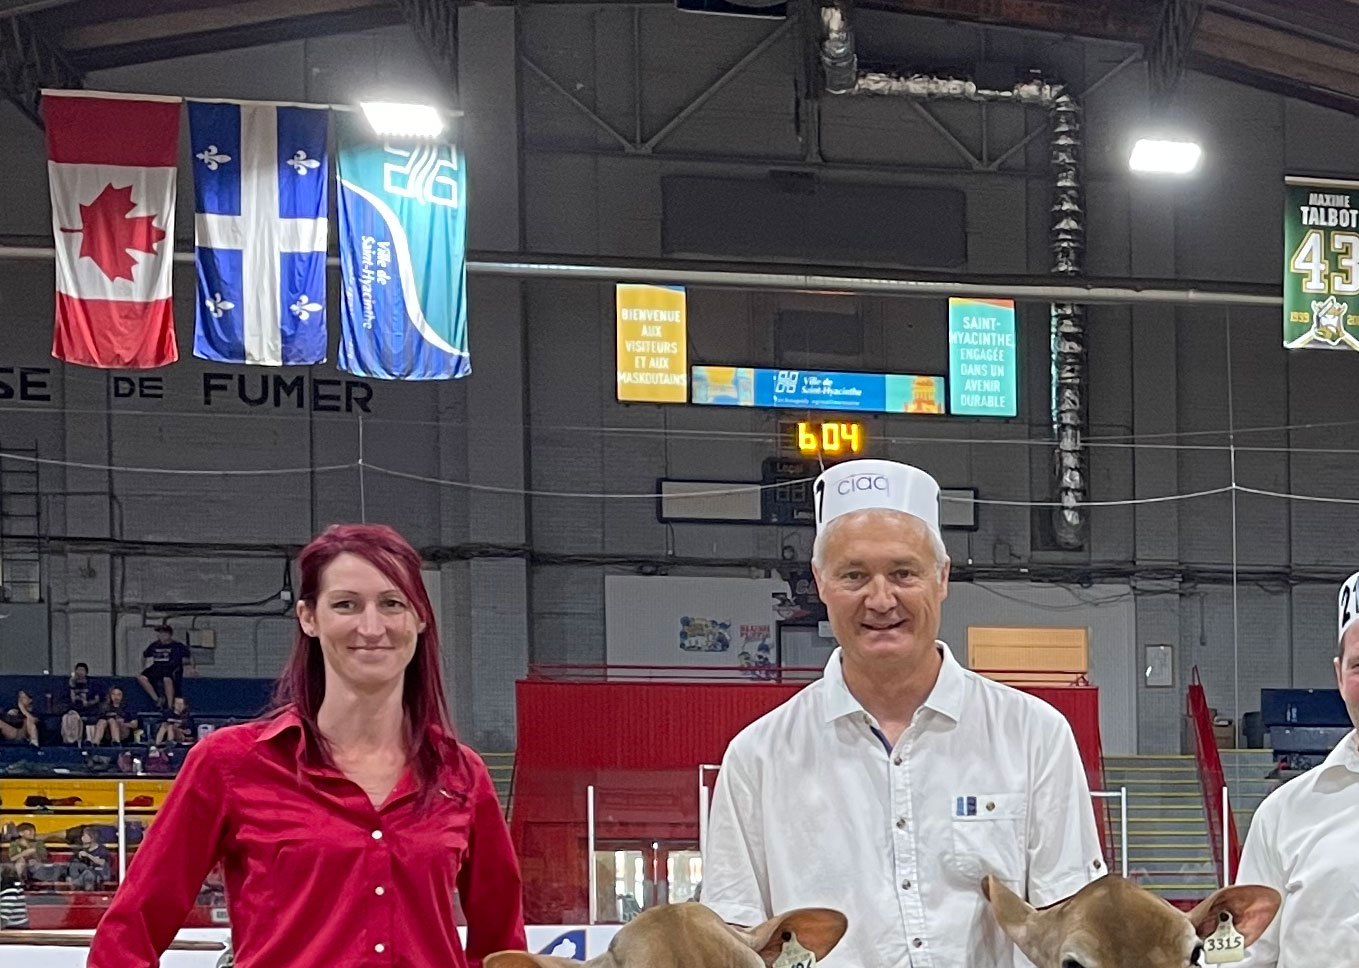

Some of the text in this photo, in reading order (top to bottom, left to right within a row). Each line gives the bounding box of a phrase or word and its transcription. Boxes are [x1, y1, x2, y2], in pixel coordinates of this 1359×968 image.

[1309, 193, 1350, 208] MAXIME
[1300, 206, 1359, 228] TALBOT
[622, 308, 681, 322] BIENVENUE
[641, 324, 662, 337] AUX
[963, 316, 1001, 331] SAINT-
[625, 340, 678, 354] VISITEURS
[960, 347, 1005, 361] ENGAGÉE
[635, 356, 669, 369] ET AUX
[960, 363, 1005, 377] DANS UN
[617, 371, 686, 386] MASKOUTAINS
[114, 377, 164, 399] DE
[203, 373, 374, 413] FUMER
[965, 380, 1000, 392] AVENIR
[960, 394, 1005, 408] DURABLE
[837, 474, 890, 498] ciaq
[1207, 936, 1242, 951] 3315
